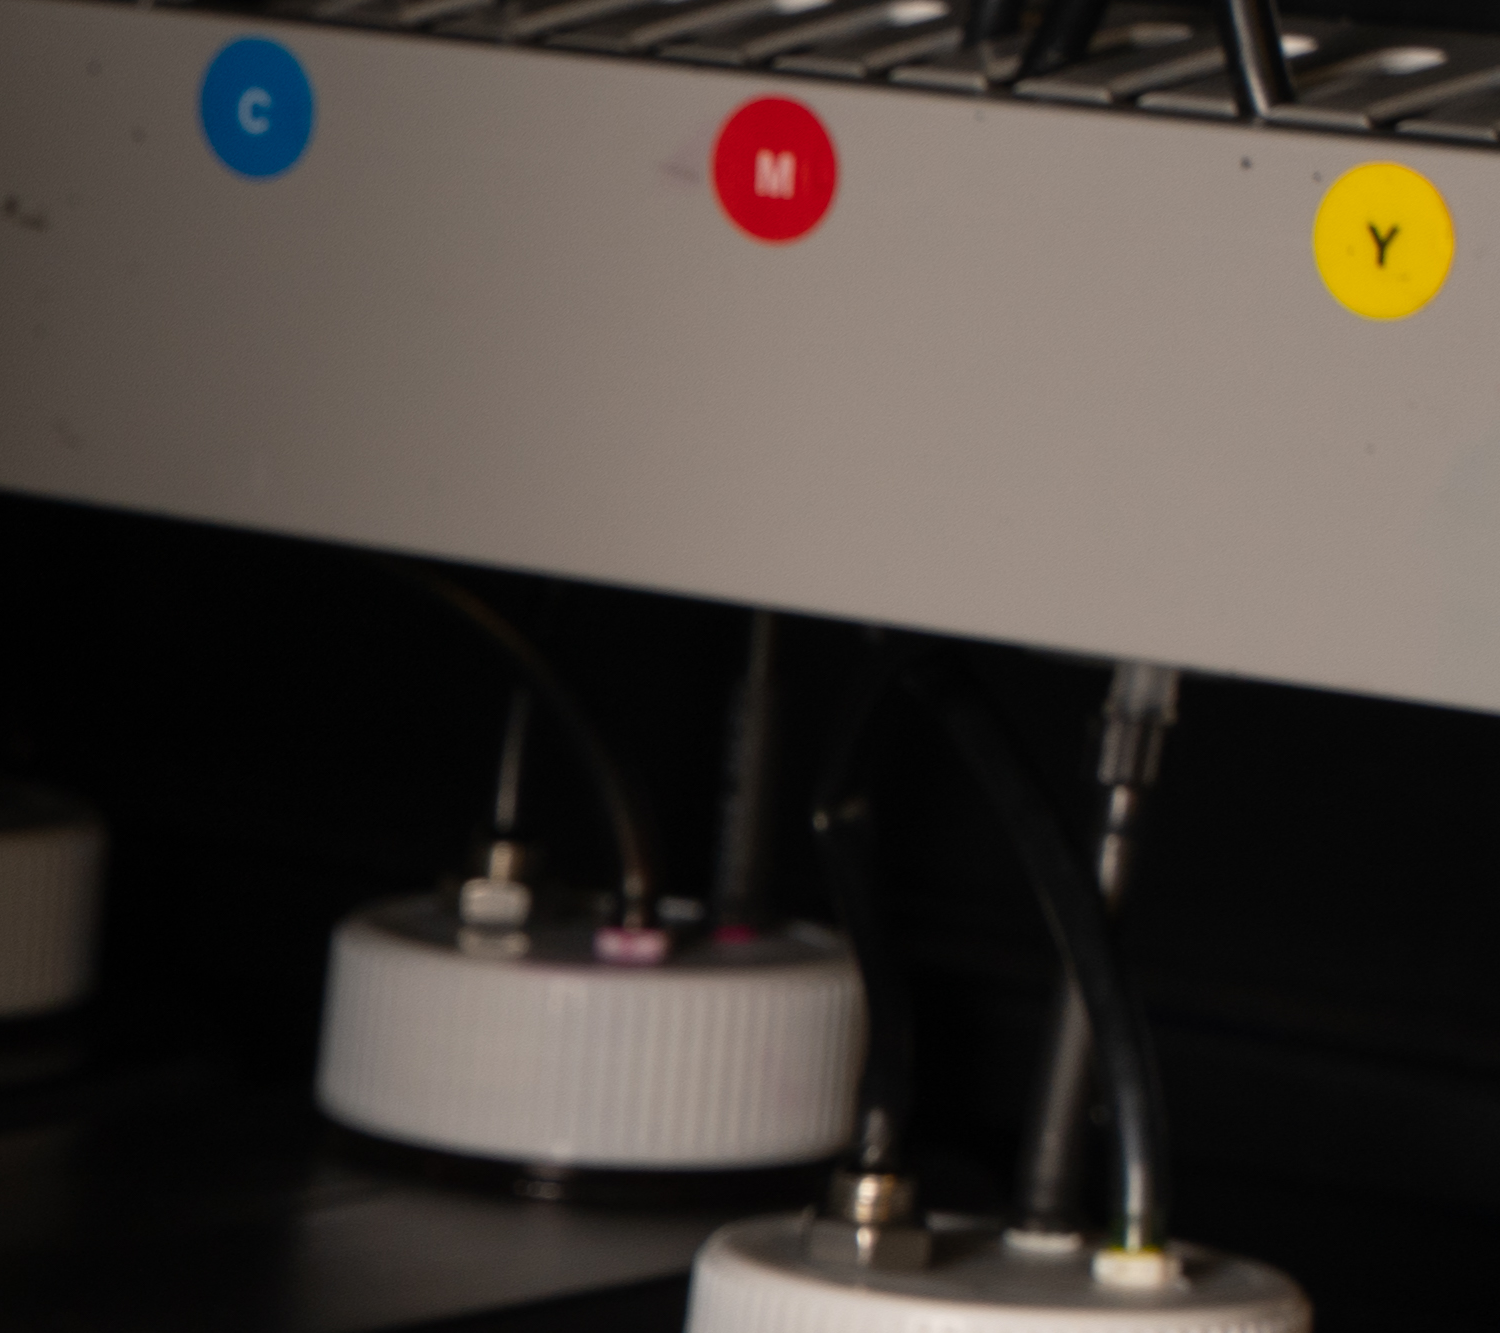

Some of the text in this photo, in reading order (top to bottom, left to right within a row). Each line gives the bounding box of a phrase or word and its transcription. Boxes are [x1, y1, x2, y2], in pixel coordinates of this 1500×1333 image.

[237, 88, 270, 135] C
[754, 149, 796, 199] M
[1366, 223, 1400, 269] Y
